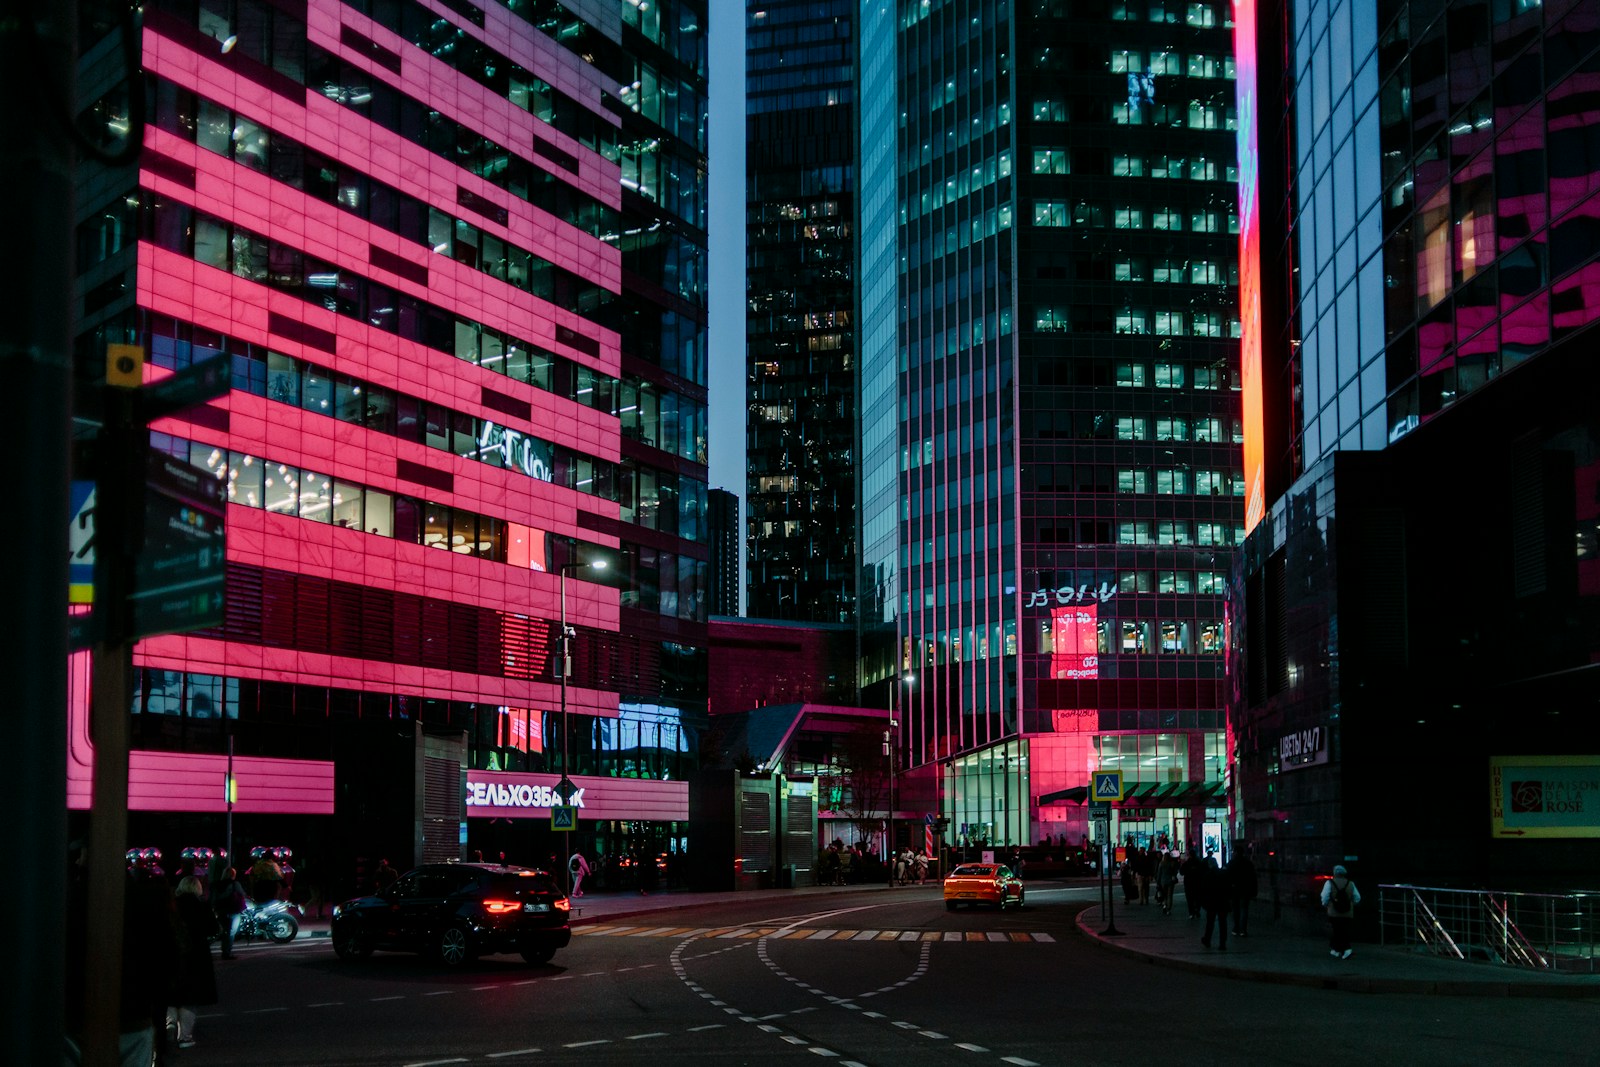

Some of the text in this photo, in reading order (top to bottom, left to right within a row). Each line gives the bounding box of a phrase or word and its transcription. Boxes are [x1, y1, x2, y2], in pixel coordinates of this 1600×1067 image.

[1280, 726, 1320, 759] ЦВЕТЫ 24/7
[465, 781, 586, 808] СЕЛЬХОЗБАК
[1545, 780, 1599, 791] MAISON
[1546, 801, 1584, 813] ROSE
